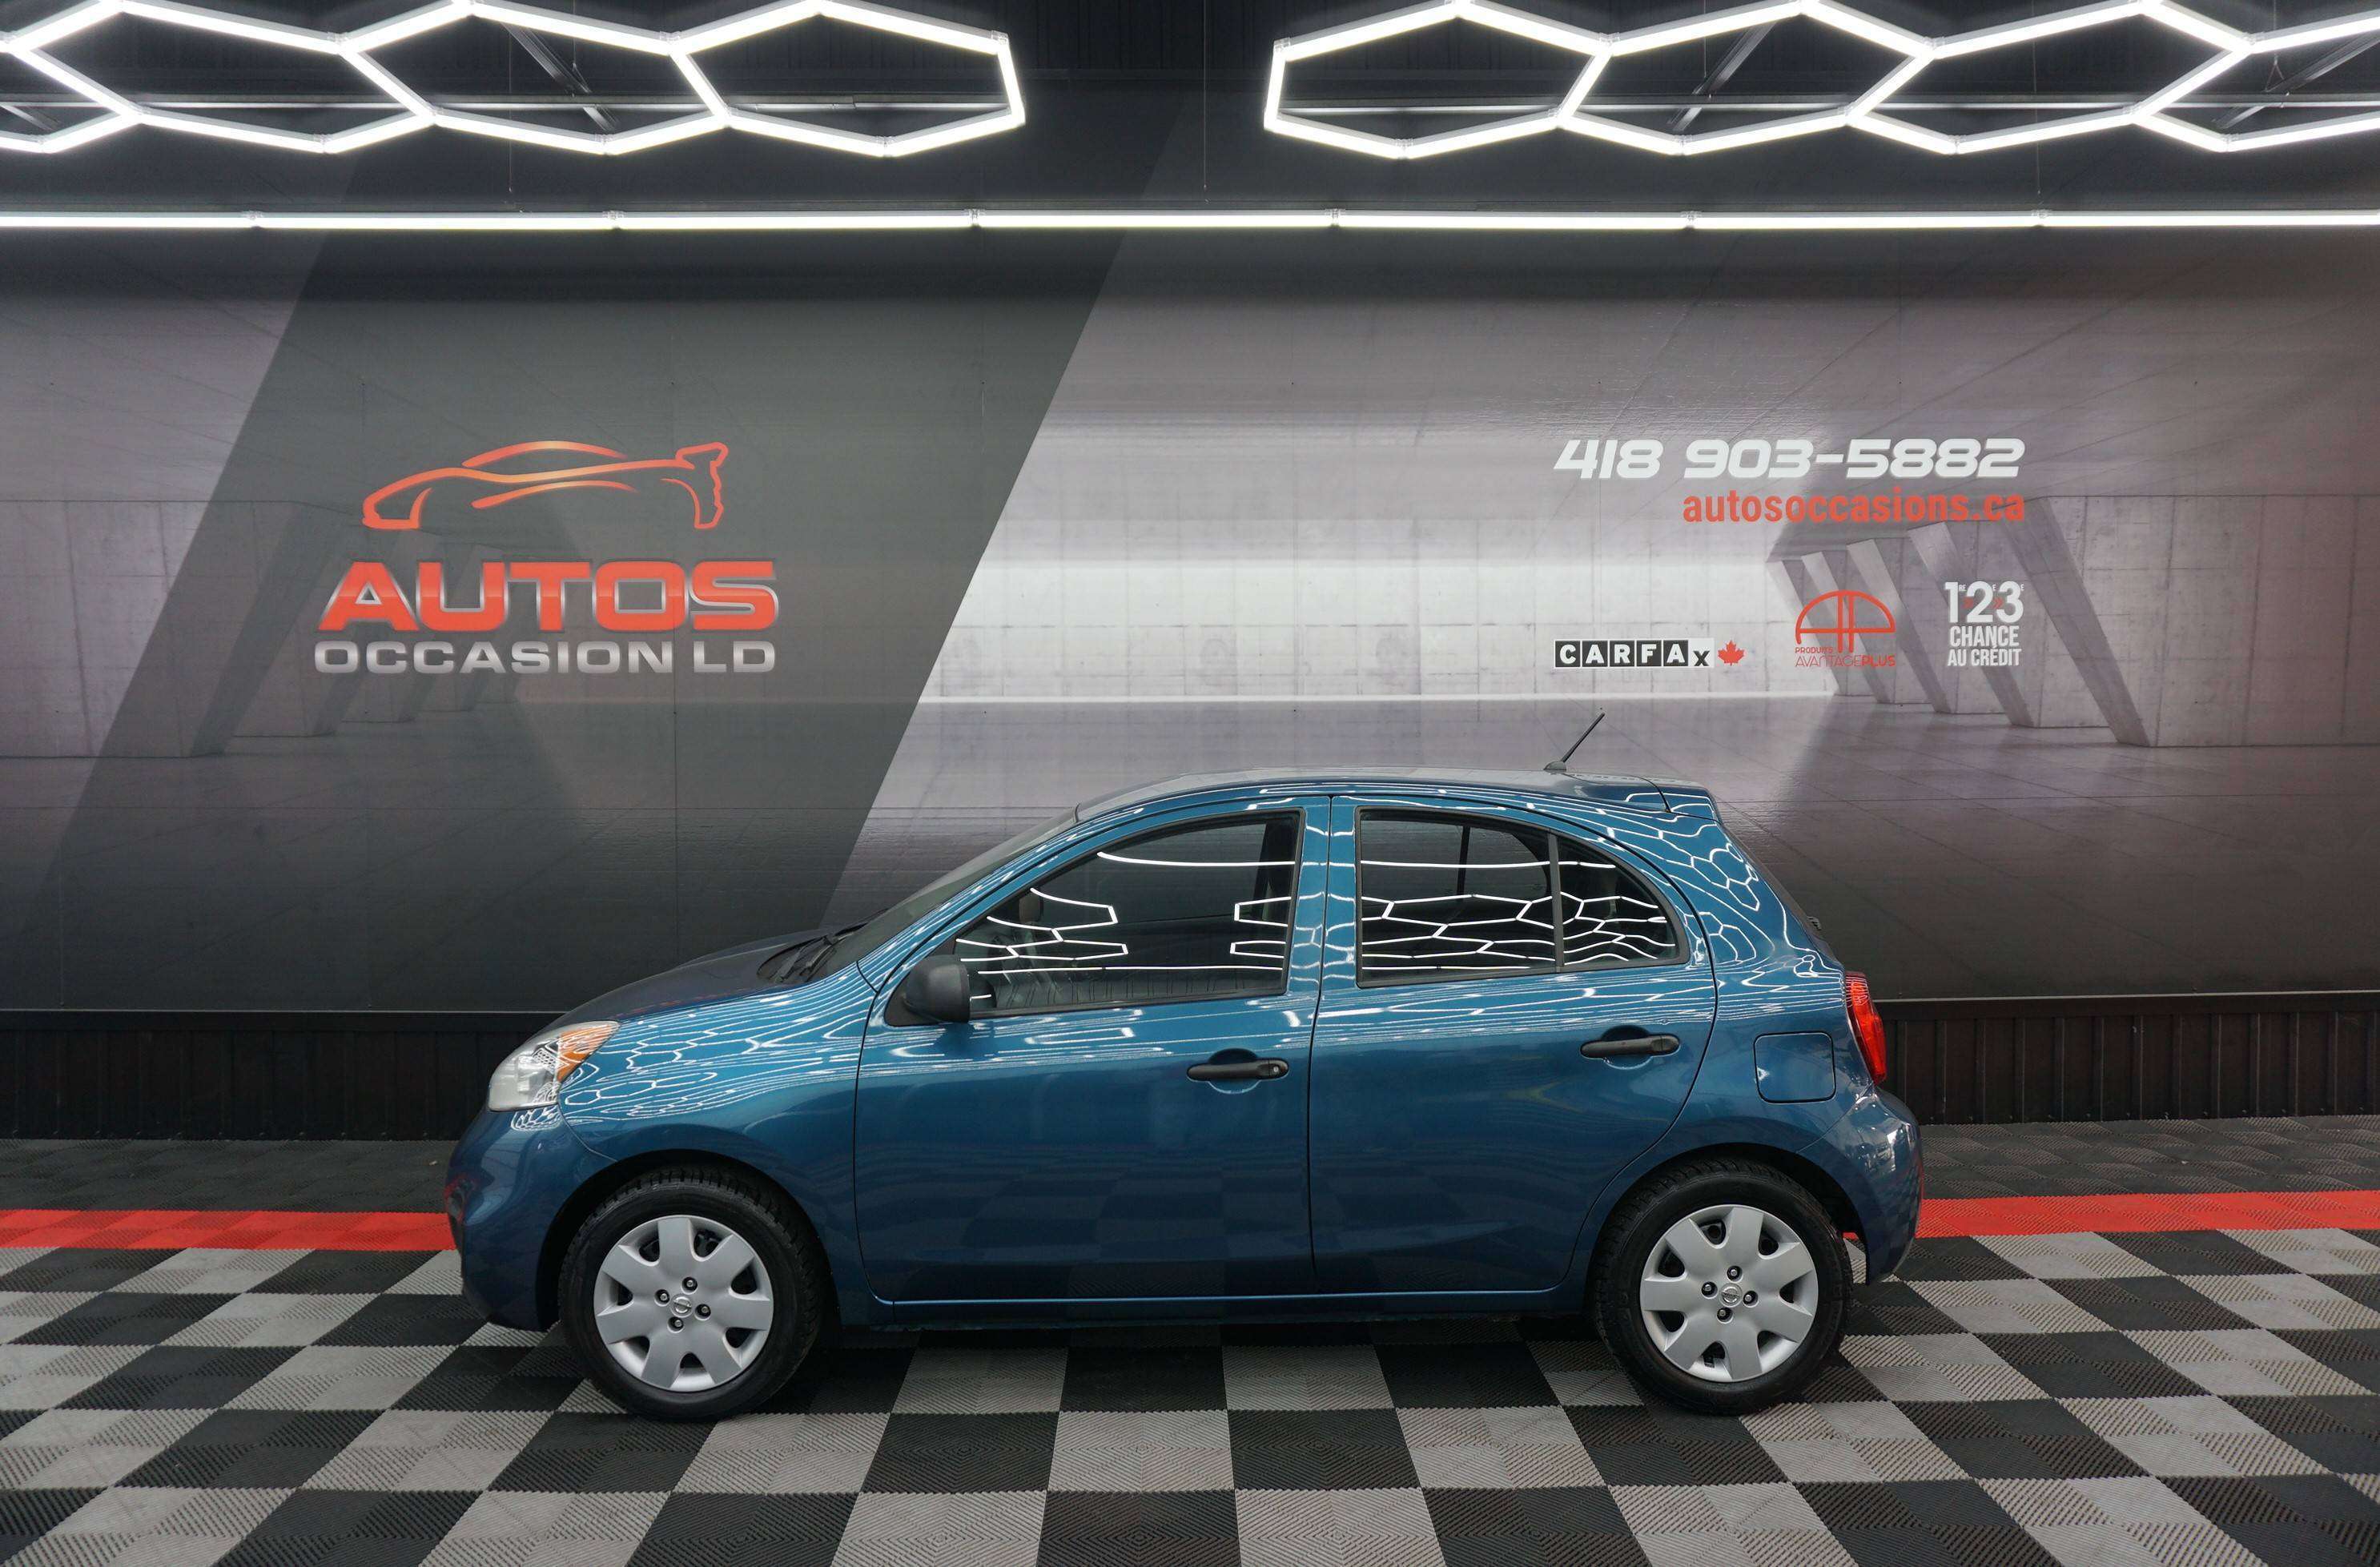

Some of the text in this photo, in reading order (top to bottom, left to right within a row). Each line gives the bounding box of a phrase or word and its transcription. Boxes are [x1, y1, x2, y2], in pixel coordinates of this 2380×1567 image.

[1554, 438, 2026, 479] 418 903-5882
[1682, 488, 2024, 523] autosoccasions.ca
[319, 561, 781, 631] AUTOS
[1949, 625, 2020, 647] CHANCE
[315, 641, 777, 674] OCCASION LD
[1948, 644, 2021, 666] AU CRÉDIT
